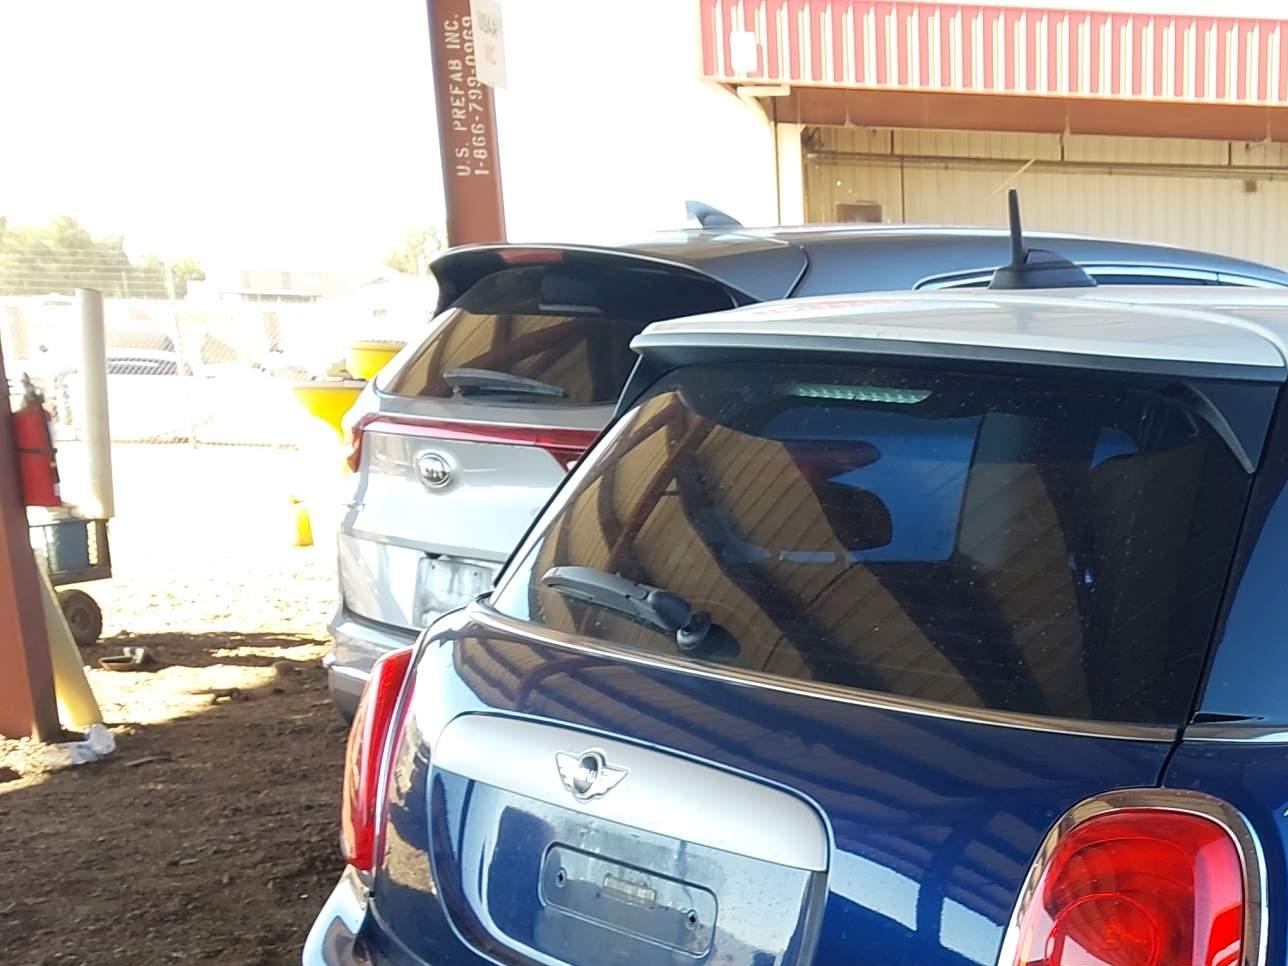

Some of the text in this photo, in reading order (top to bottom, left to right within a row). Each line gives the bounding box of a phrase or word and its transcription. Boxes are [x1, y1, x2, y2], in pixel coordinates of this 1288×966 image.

[444, 14, 472, 176] U.S. PREFAB INC.
